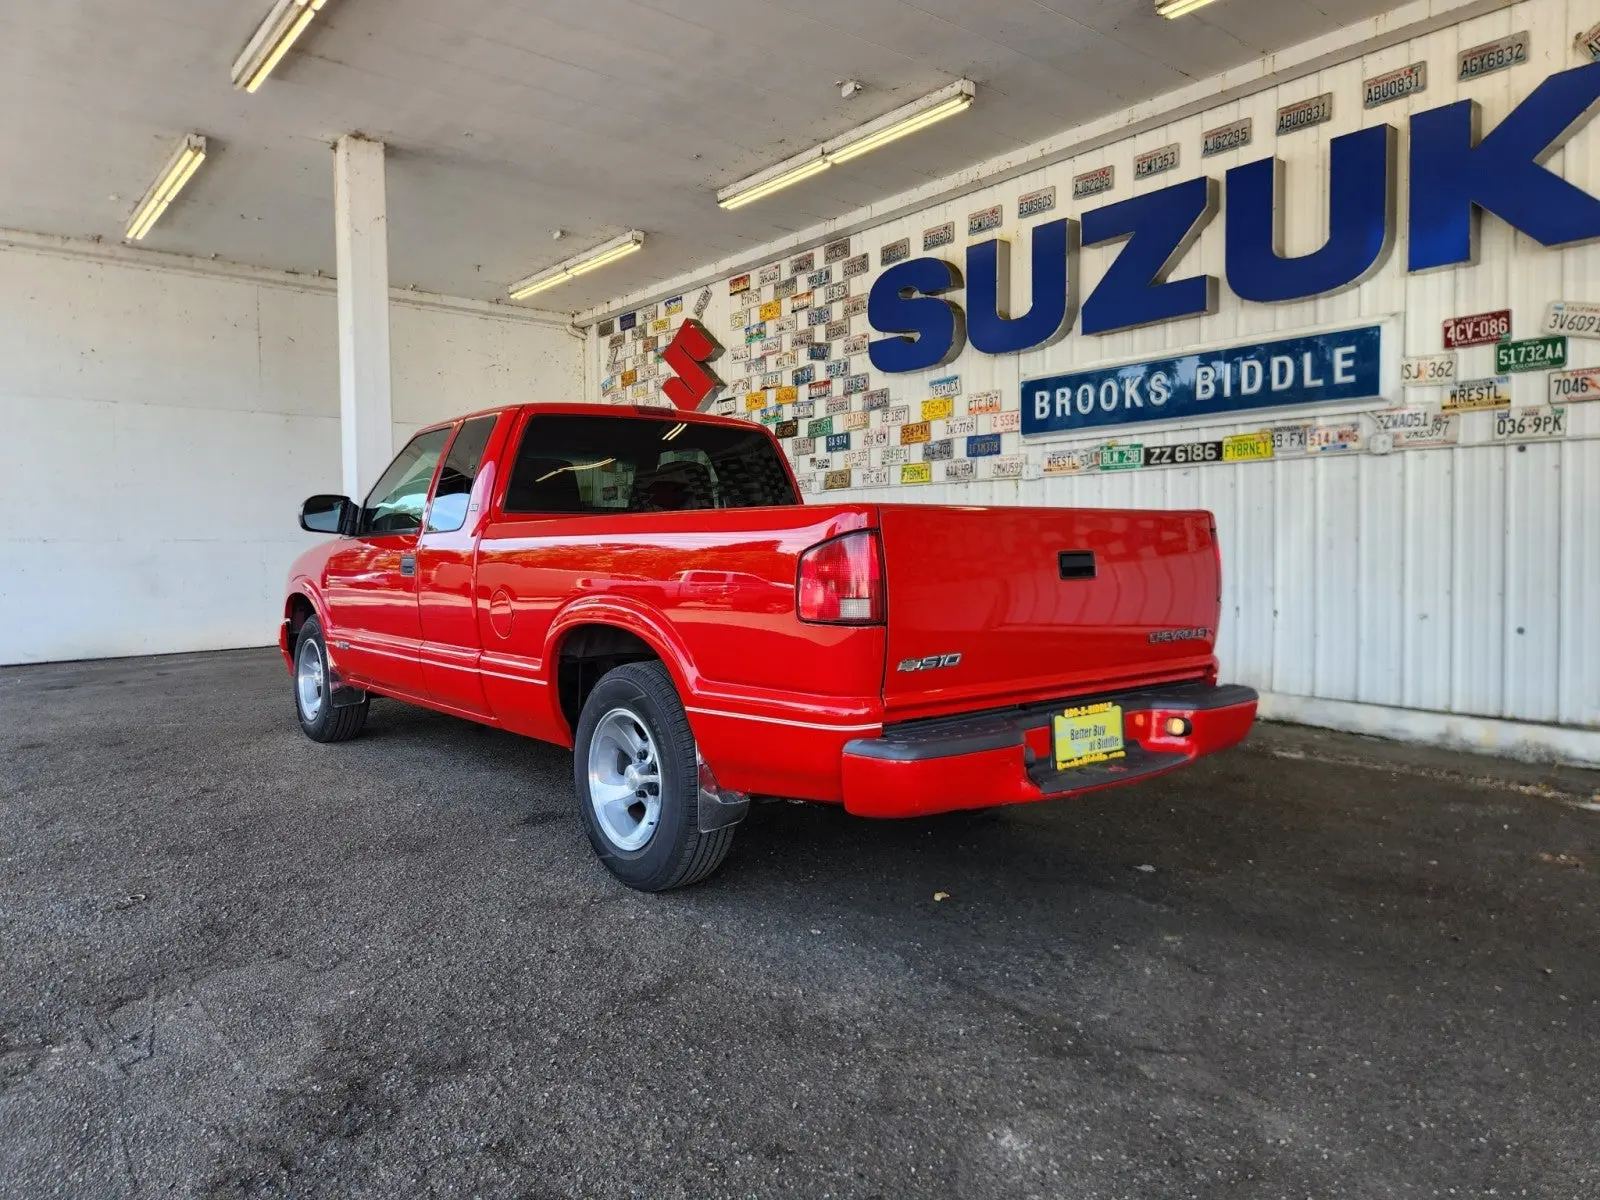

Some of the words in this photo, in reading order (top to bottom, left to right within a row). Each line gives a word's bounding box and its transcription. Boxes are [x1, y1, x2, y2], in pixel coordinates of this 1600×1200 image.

[1461, 43, 1523, 76] AGY6832
[1367, 72, 1419, 103] ABU0831
[1279, 102, 1325, 130] ABU0831
[1203, 127, 1247, 153] AJG2295
[1446, 317, 1508, 341] 4CV-086
[1500, 342, 1563, 365] 51732AA
[1428, 360, 1453, 378] 362
[1034, 371, 1171, 420] BROOKS
[1195, 345, 1357, 401] BIDDLE
[1553, 377, 1588, 395] 7046
[1449, 385, 1503, 404] WRESTL
[836, 435, 847, 446] 974
[1047, 455, 1076, 468] WRESTL
[1149, 448, 1171, 464] ZZ
[1174, 443, 1217, 462] 6186
[1149, 628, 1208, 644] CHEVROLET
[919, 653, 961, 669] S10
[1070, 728, 1091, 741] Better
[1093, 725, 1106, 737] Buy
